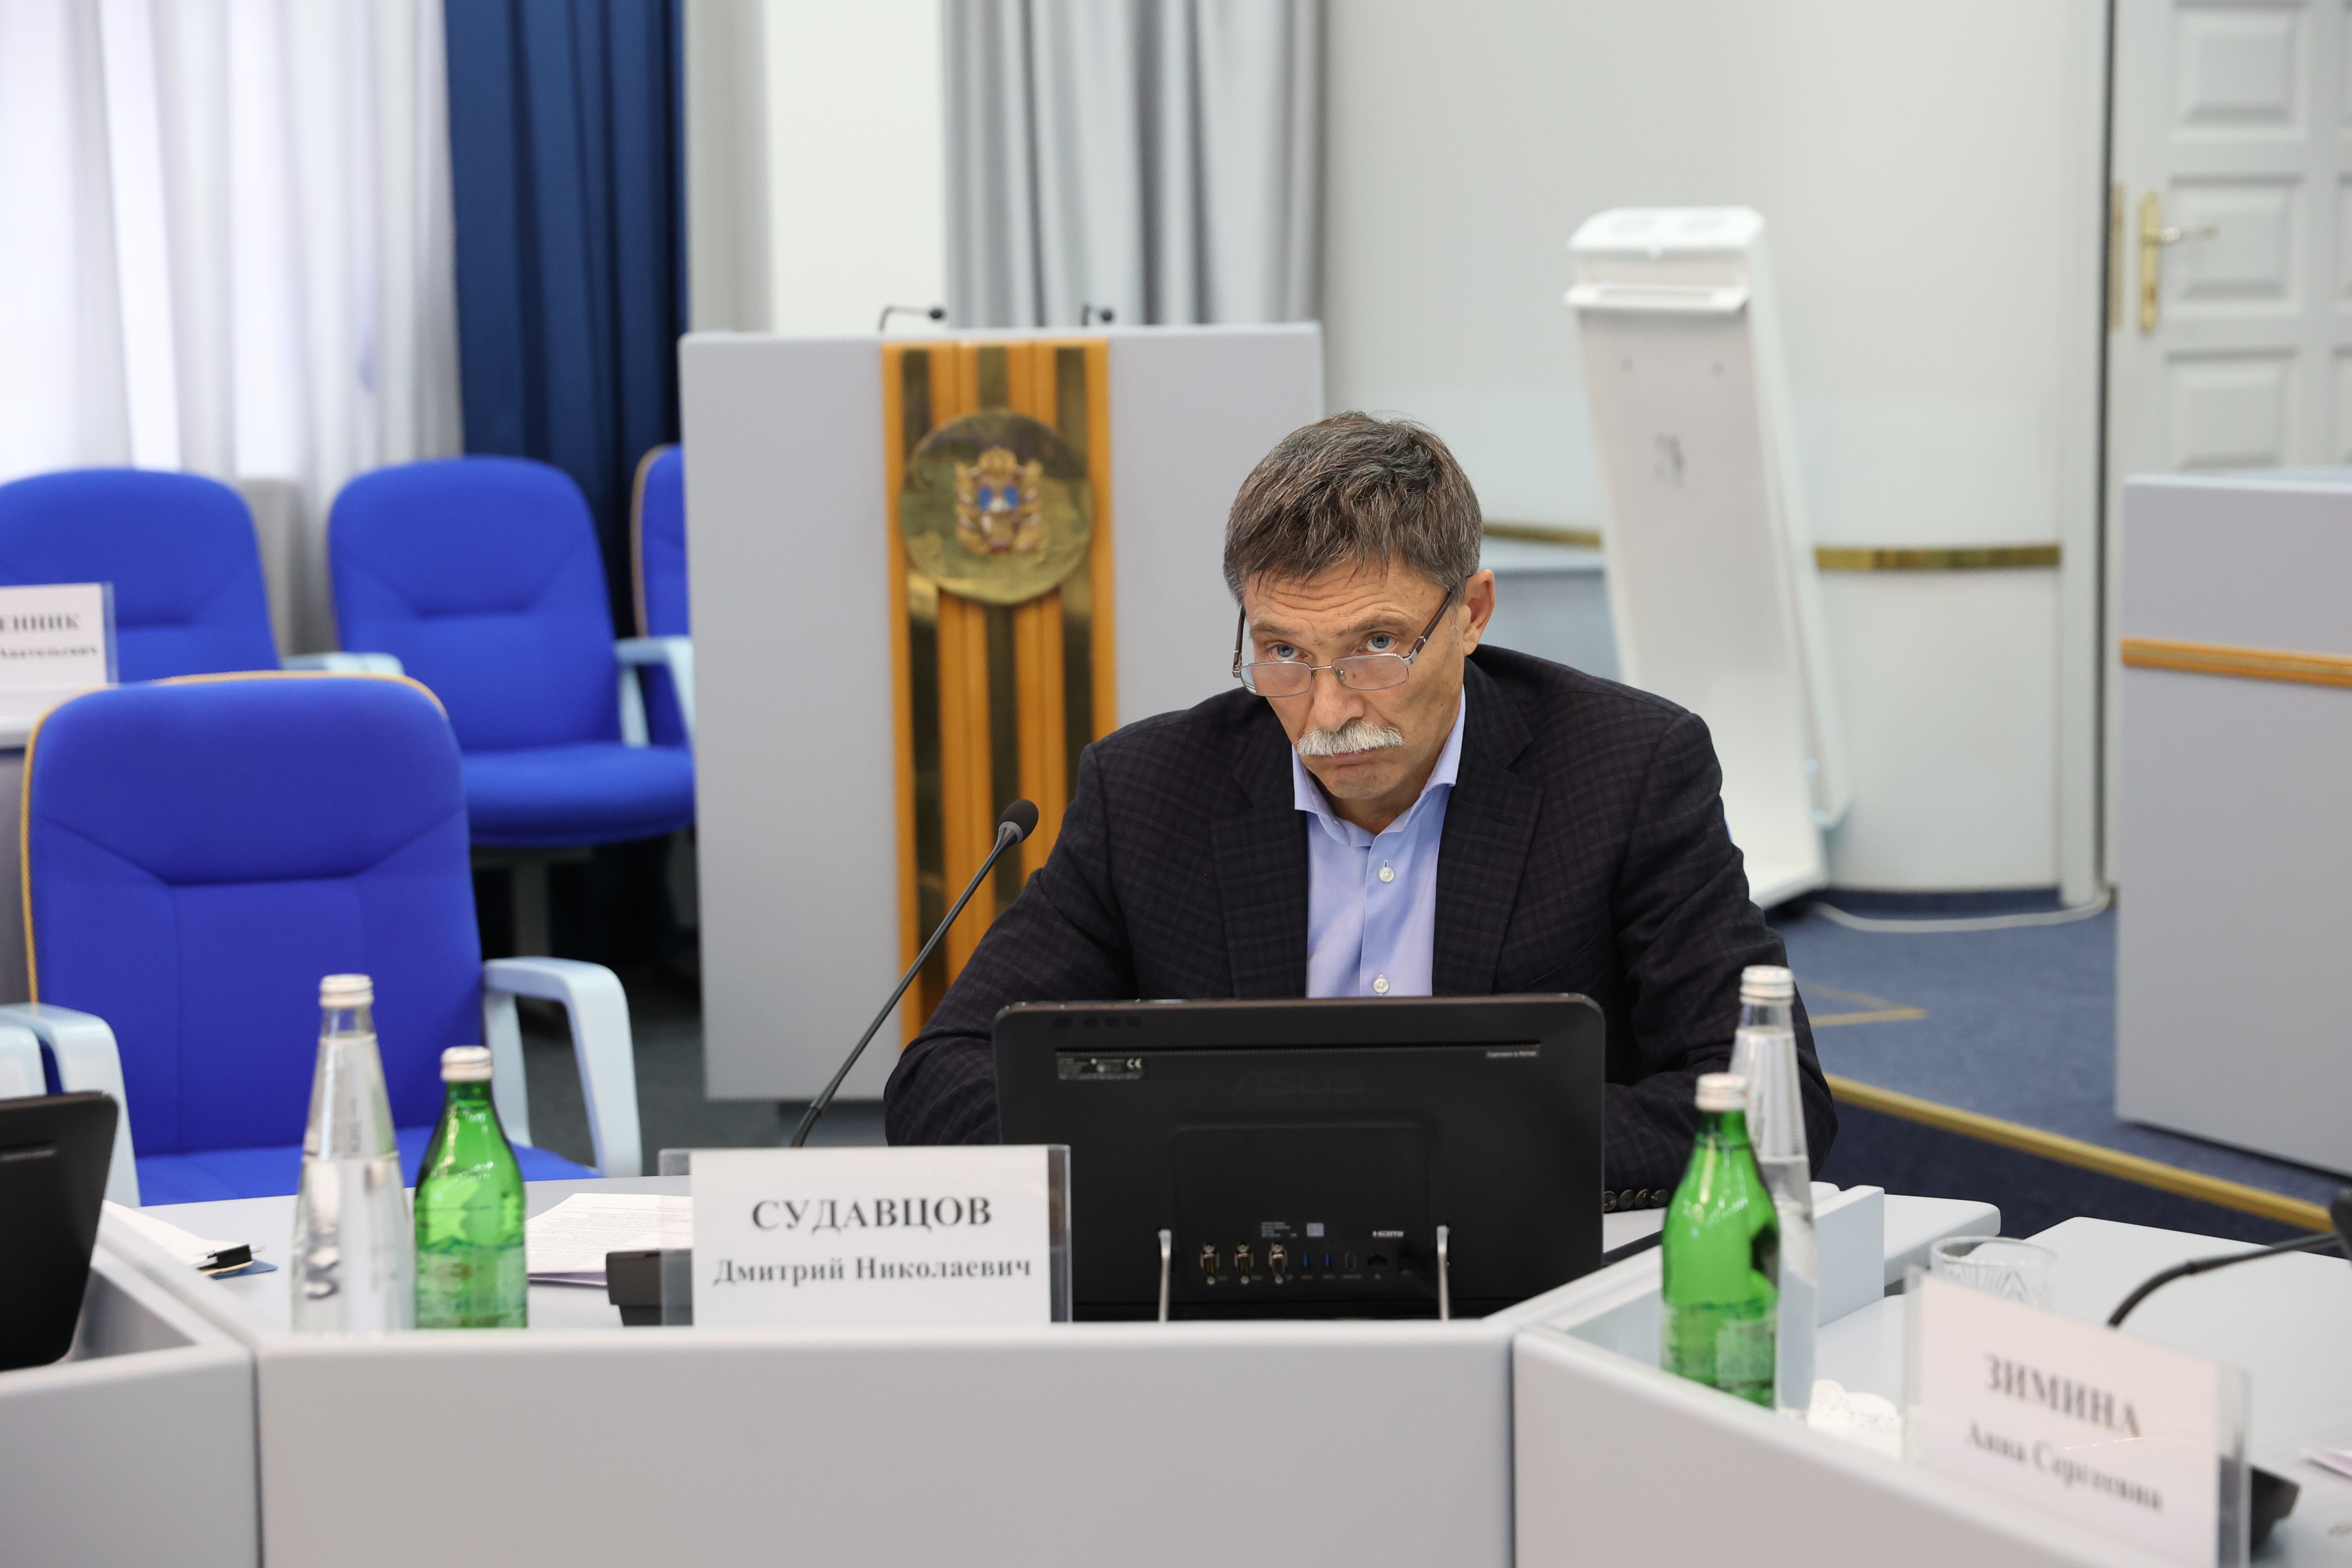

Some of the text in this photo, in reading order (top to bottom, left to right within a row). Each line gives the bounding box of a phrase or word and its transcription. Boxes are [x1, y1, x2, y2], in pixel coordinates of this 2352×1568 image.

[751, 1196, 992, 1234] СУДАВЦОВ
[714, 1257, 1031, 1286] Дмитрий Николаевич
[1983, 1353, 2141, 1437] ЗИМИНА
[1966, 1419, 2026, 1462] Анна
